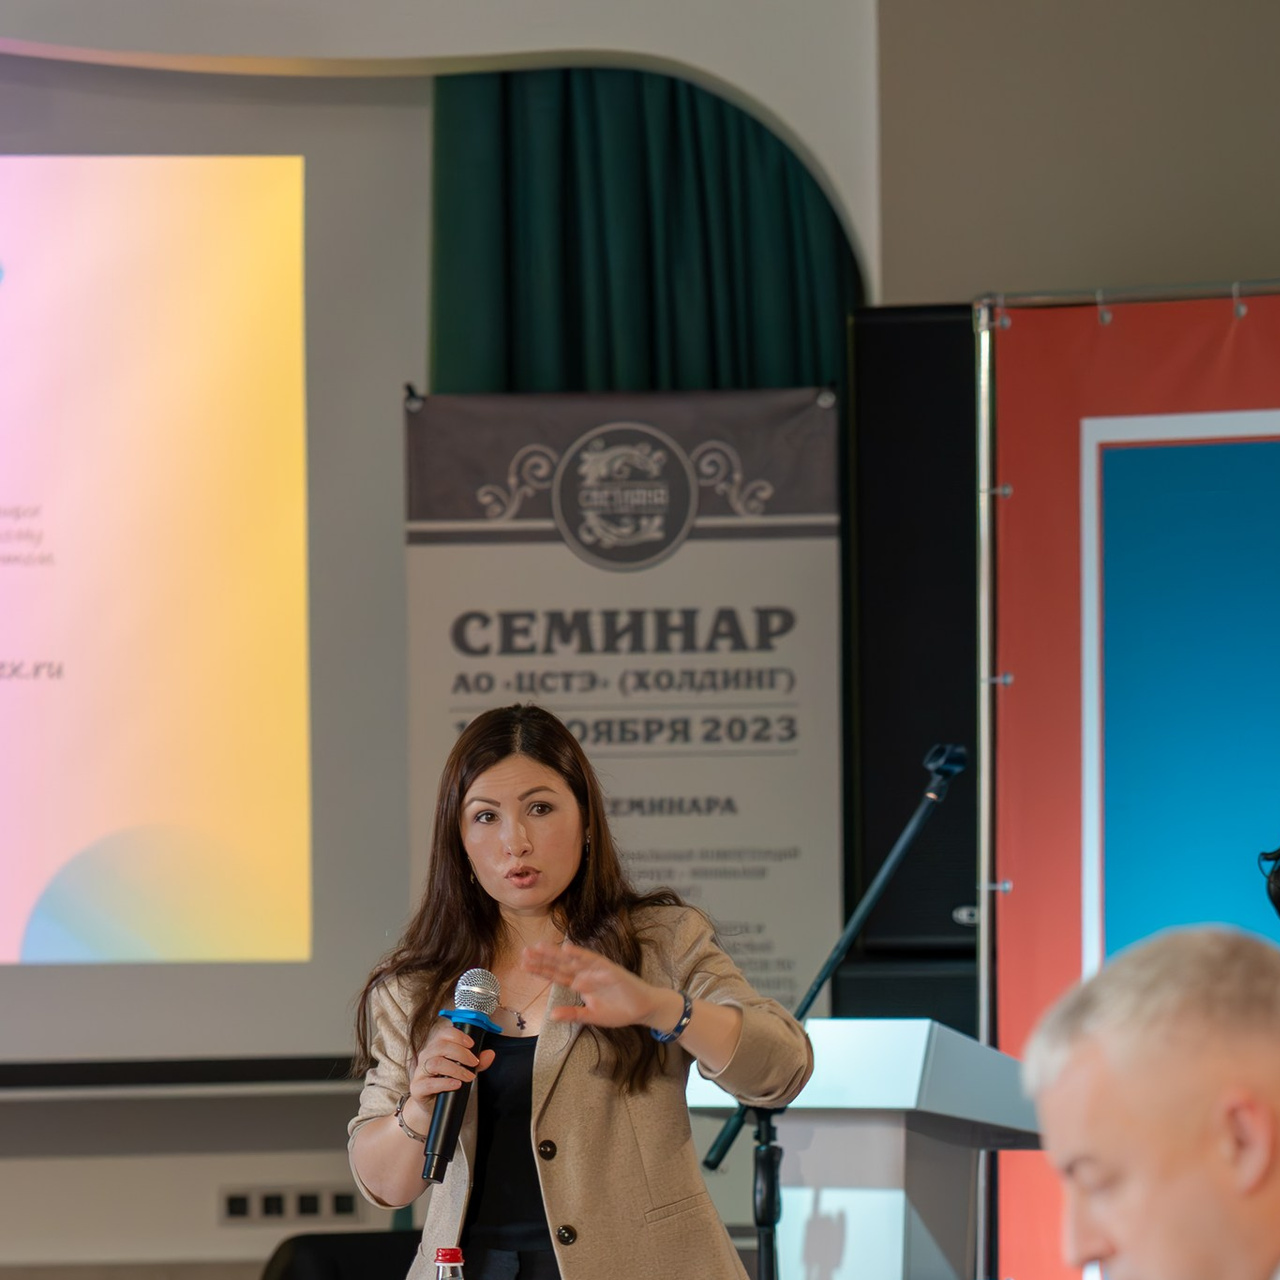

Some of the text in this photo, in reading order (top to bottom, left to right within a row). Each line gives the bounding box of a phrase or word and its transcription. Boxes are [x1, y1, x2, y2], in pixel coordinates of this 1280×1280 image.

[450, 606, 797, 658] СЕМИНАР
[451, 671, 496, 696] АО
[619, 666, 797, 698] (ХОЛДИНГ)
[566, 714, 798, 745] ОЯБРЯ 2023
[608, 796, 738, 817] ЕМИНАРА
